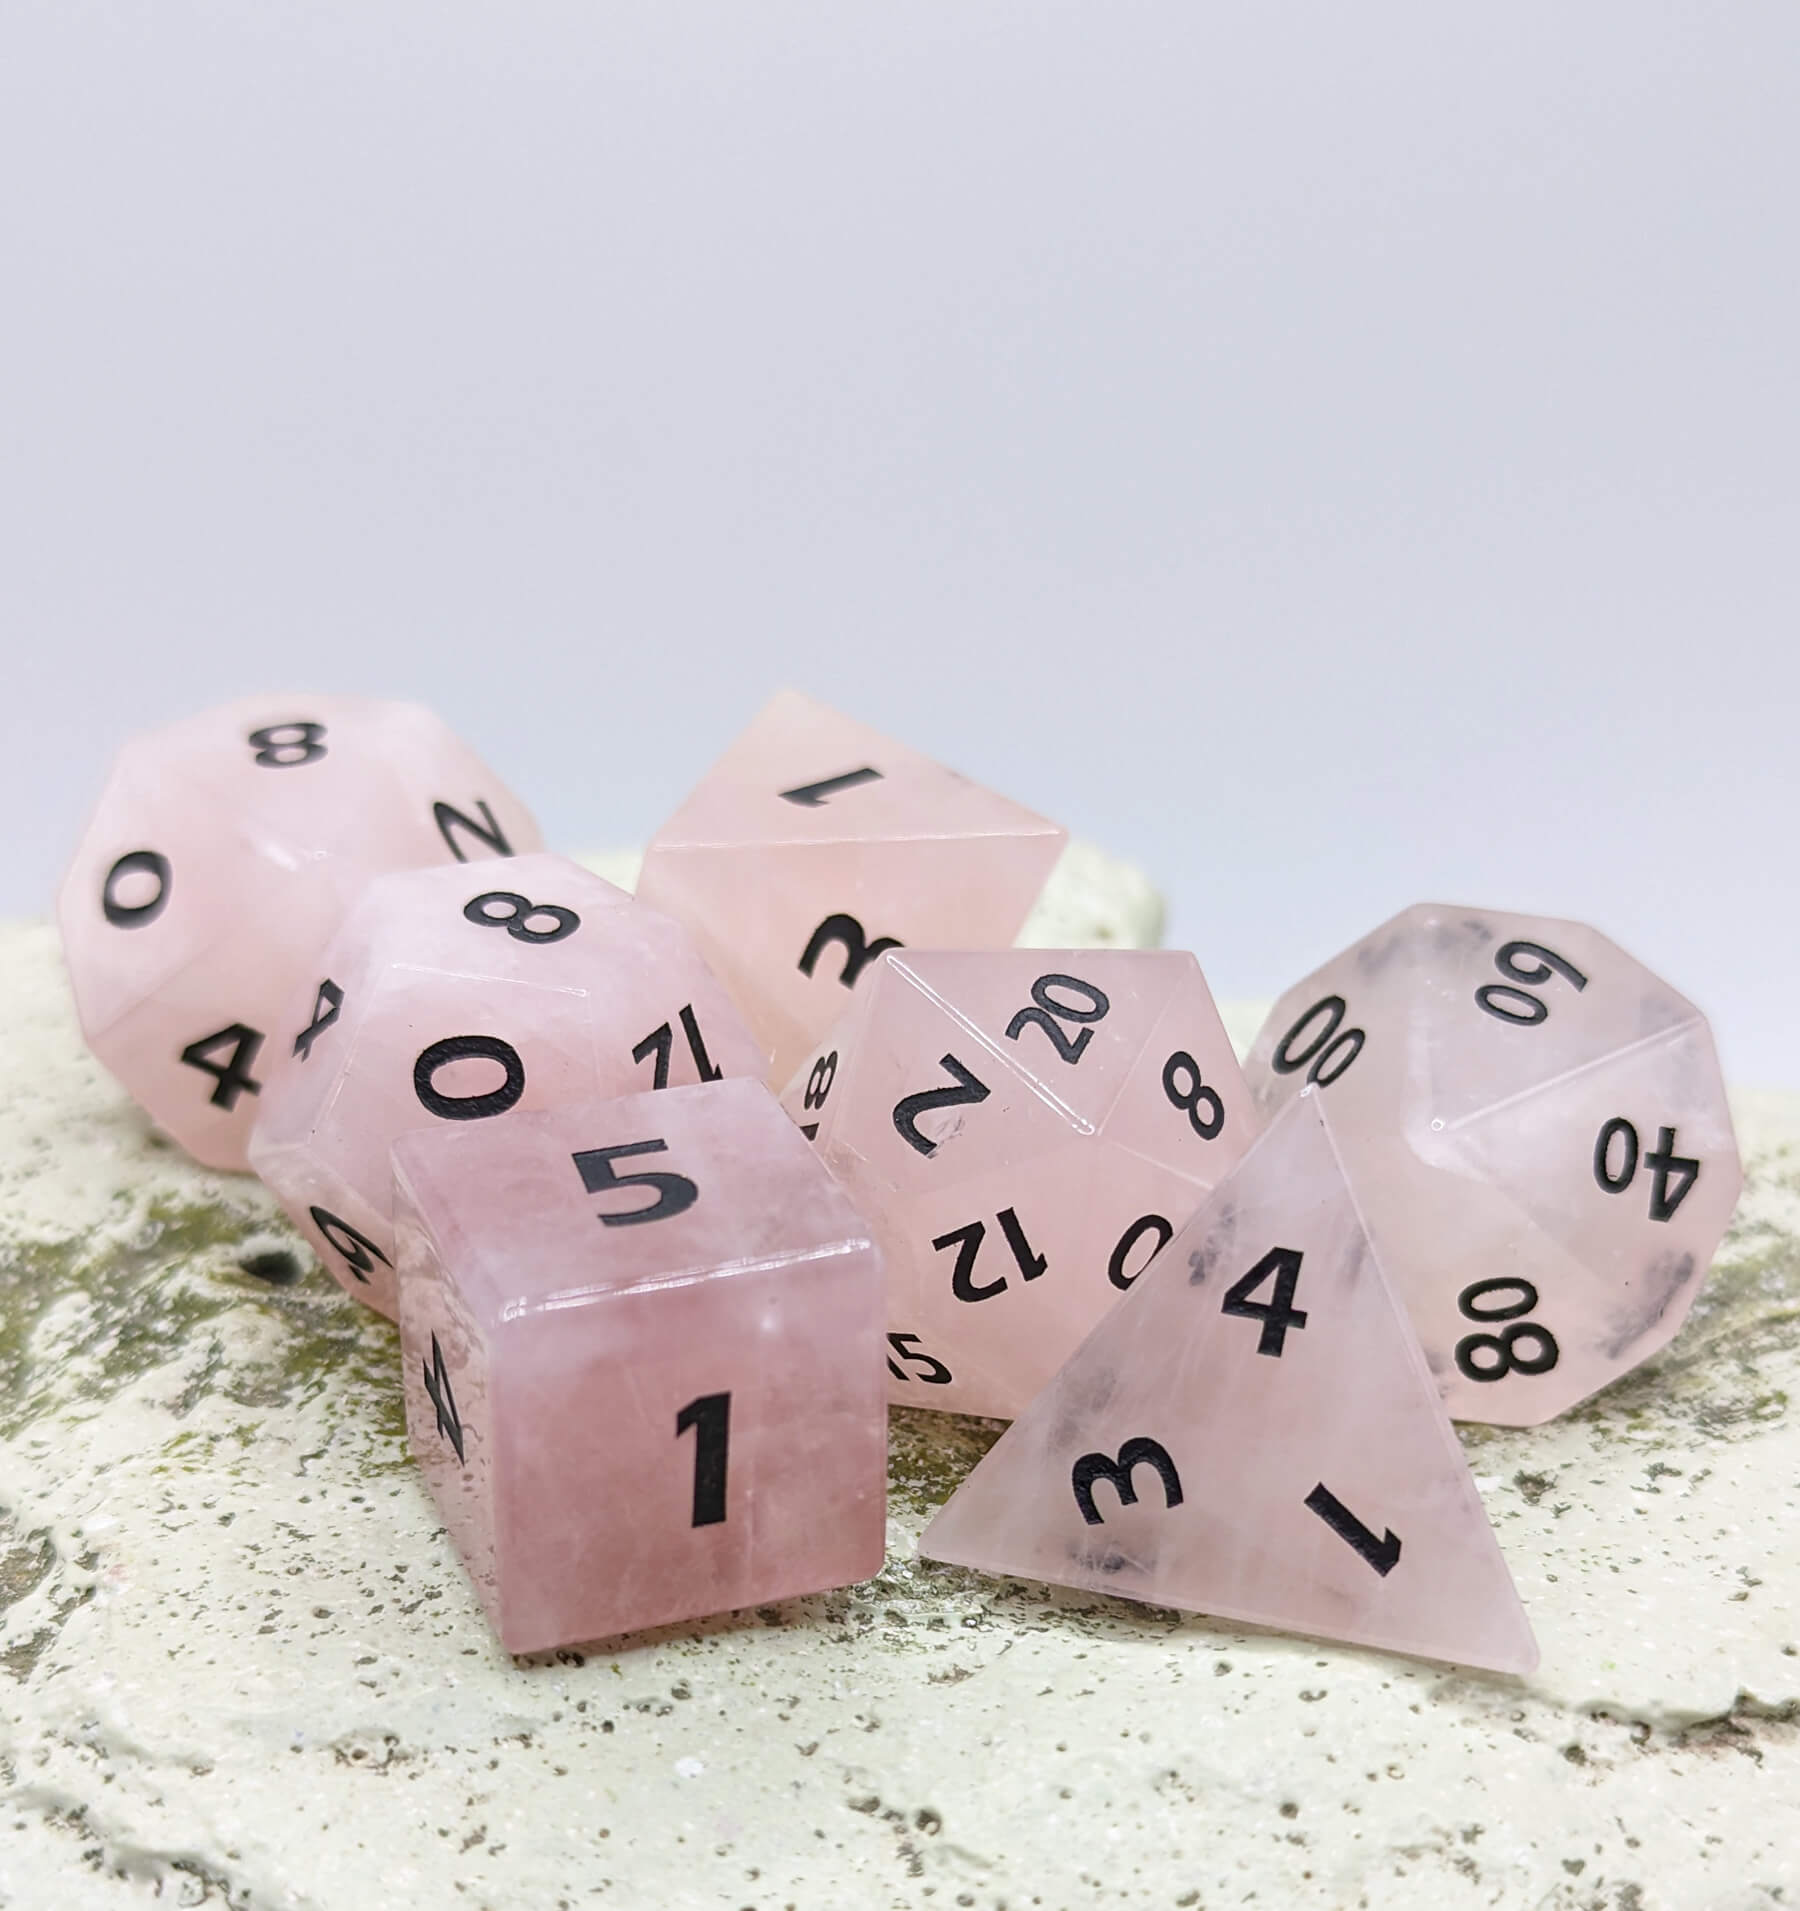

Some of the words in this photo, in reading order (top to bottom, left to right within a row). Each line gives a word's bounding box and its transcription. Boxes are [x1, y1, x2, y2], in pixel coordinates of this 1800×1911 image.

[247, 721, 327, 768] 8
[778, 767, 883, 807] 1
[463, 891, 581, 945] 8
[797, 913, 905, 989] 3
[1004, 973, 1111, 1065] 20
[1272, 994, 1366, 1089] 00
[180, 1022, 264, 1111] 4
[1162, 1050, 1225, 1141] 8
[570, 1138, 699, 1227] 5
[1594, 1116, 1701, 1223] 40
[931, 1206, 1049, 1303] 12
[1220, 1246, 1308, 1358] 4
[1454, 1277, 1560, 1383] 80
[675, 1391, 732, 1529] 1
[1071, 1436, 1184, 1526] 3
[1303, 1481, 1403, 1578] 1
